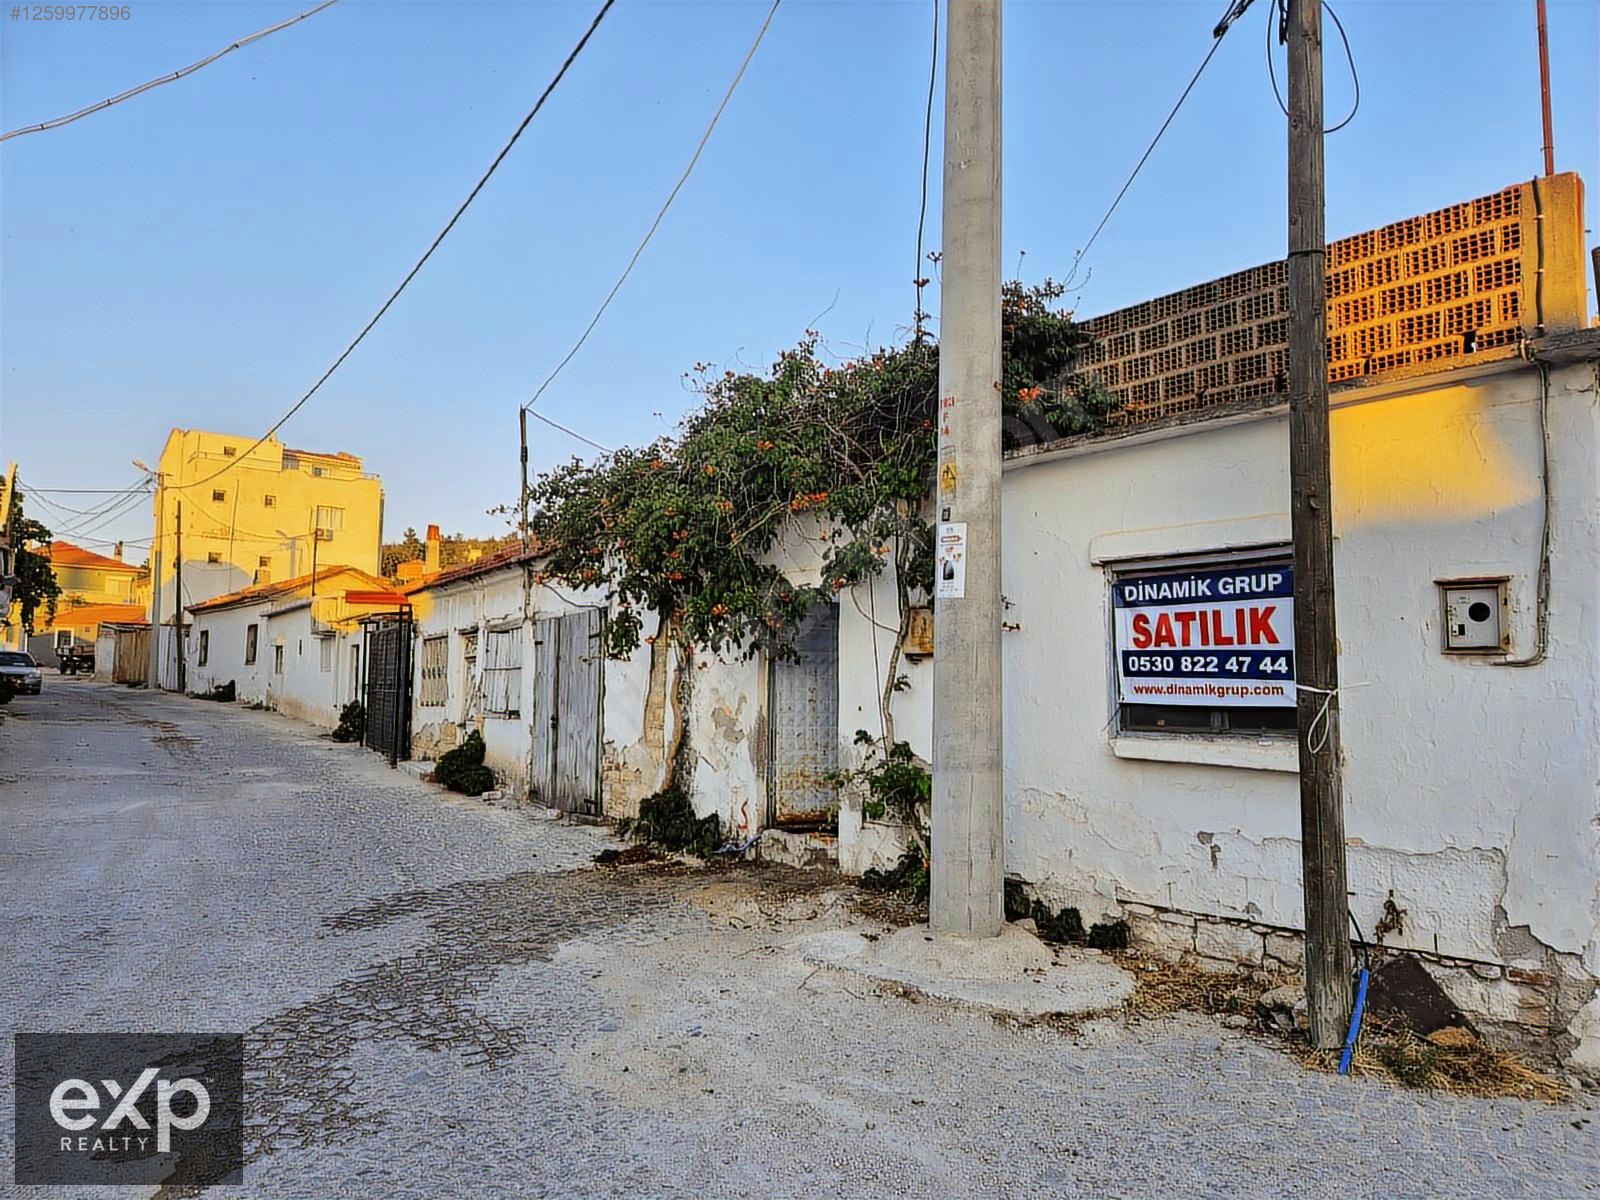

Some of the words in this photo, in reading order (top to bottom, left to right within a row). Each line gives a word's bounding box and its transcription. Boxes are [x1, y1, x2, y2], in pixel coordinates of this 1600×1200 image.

[1218, 573, 1283, 595] GRUP
[1132, 606, 1280, 649] SATILIK
[1128, 656, 1174, 672] 0530
[1180, 656, 1219, 672] 822
[1225, 656, 1252, 673] 47
[1259, 657, 1289, 674] 44
[1133, 683, 1284, 698] www.dinamikgrup.com
